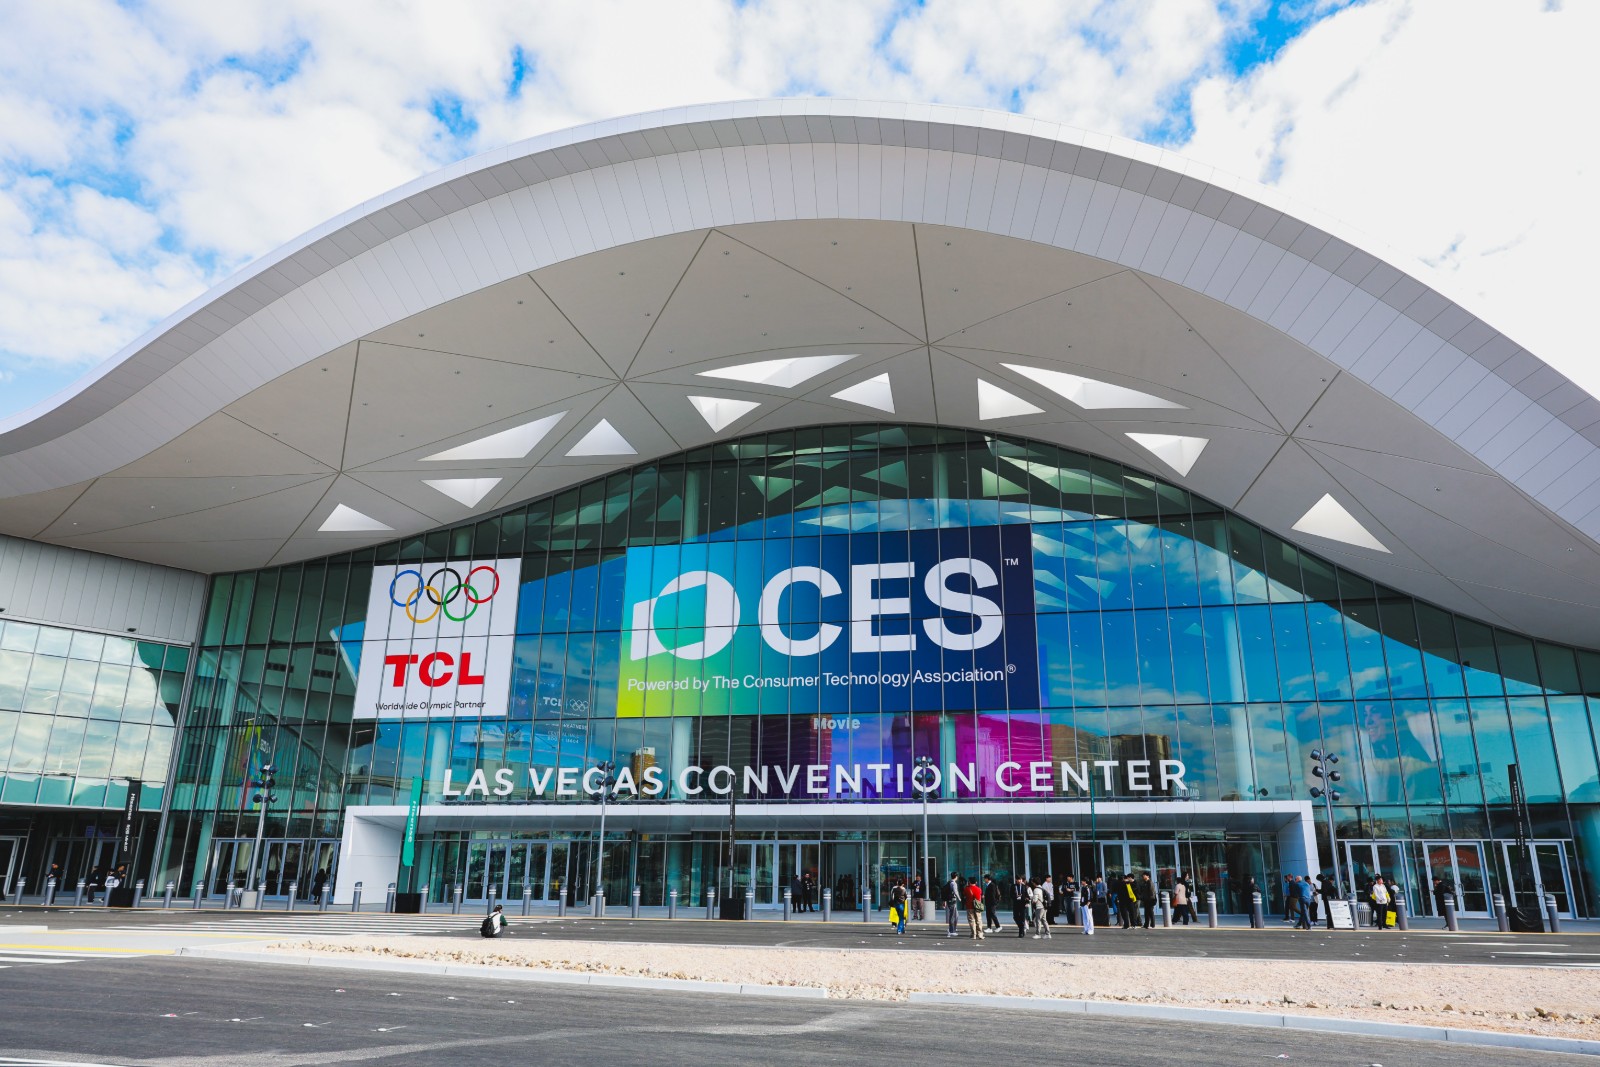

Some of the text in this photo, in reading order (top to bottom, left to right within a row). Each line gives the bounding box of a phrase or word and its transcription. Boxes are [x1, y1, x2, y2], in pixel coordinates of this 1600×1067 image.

[758, 557, 1004, 656] CES
[385, 651, 485, 687] TCL
[627, 677, 689, 692] Powered
[692, 677, 709, 693] by
[712, 674, 739, 688] The
[743, 673, 820, 689] Consumer
[823, 670, 911, 689] Technology
[375, 700, 487, 711] Worldwide Olympic Partner
[542, 696, 562, 706] TCL
[813, 715, 860, 730] Movie
[442, 767, 515, 797] LAS
[528, 766, 664, 797] VEGAS
[679, 762, 976, 797] CONVENTION
[995, 759, 1188, 793] CENTER
[127, 793, 136, 821] Hisense
[408, 800, 416, 842] Hisense
